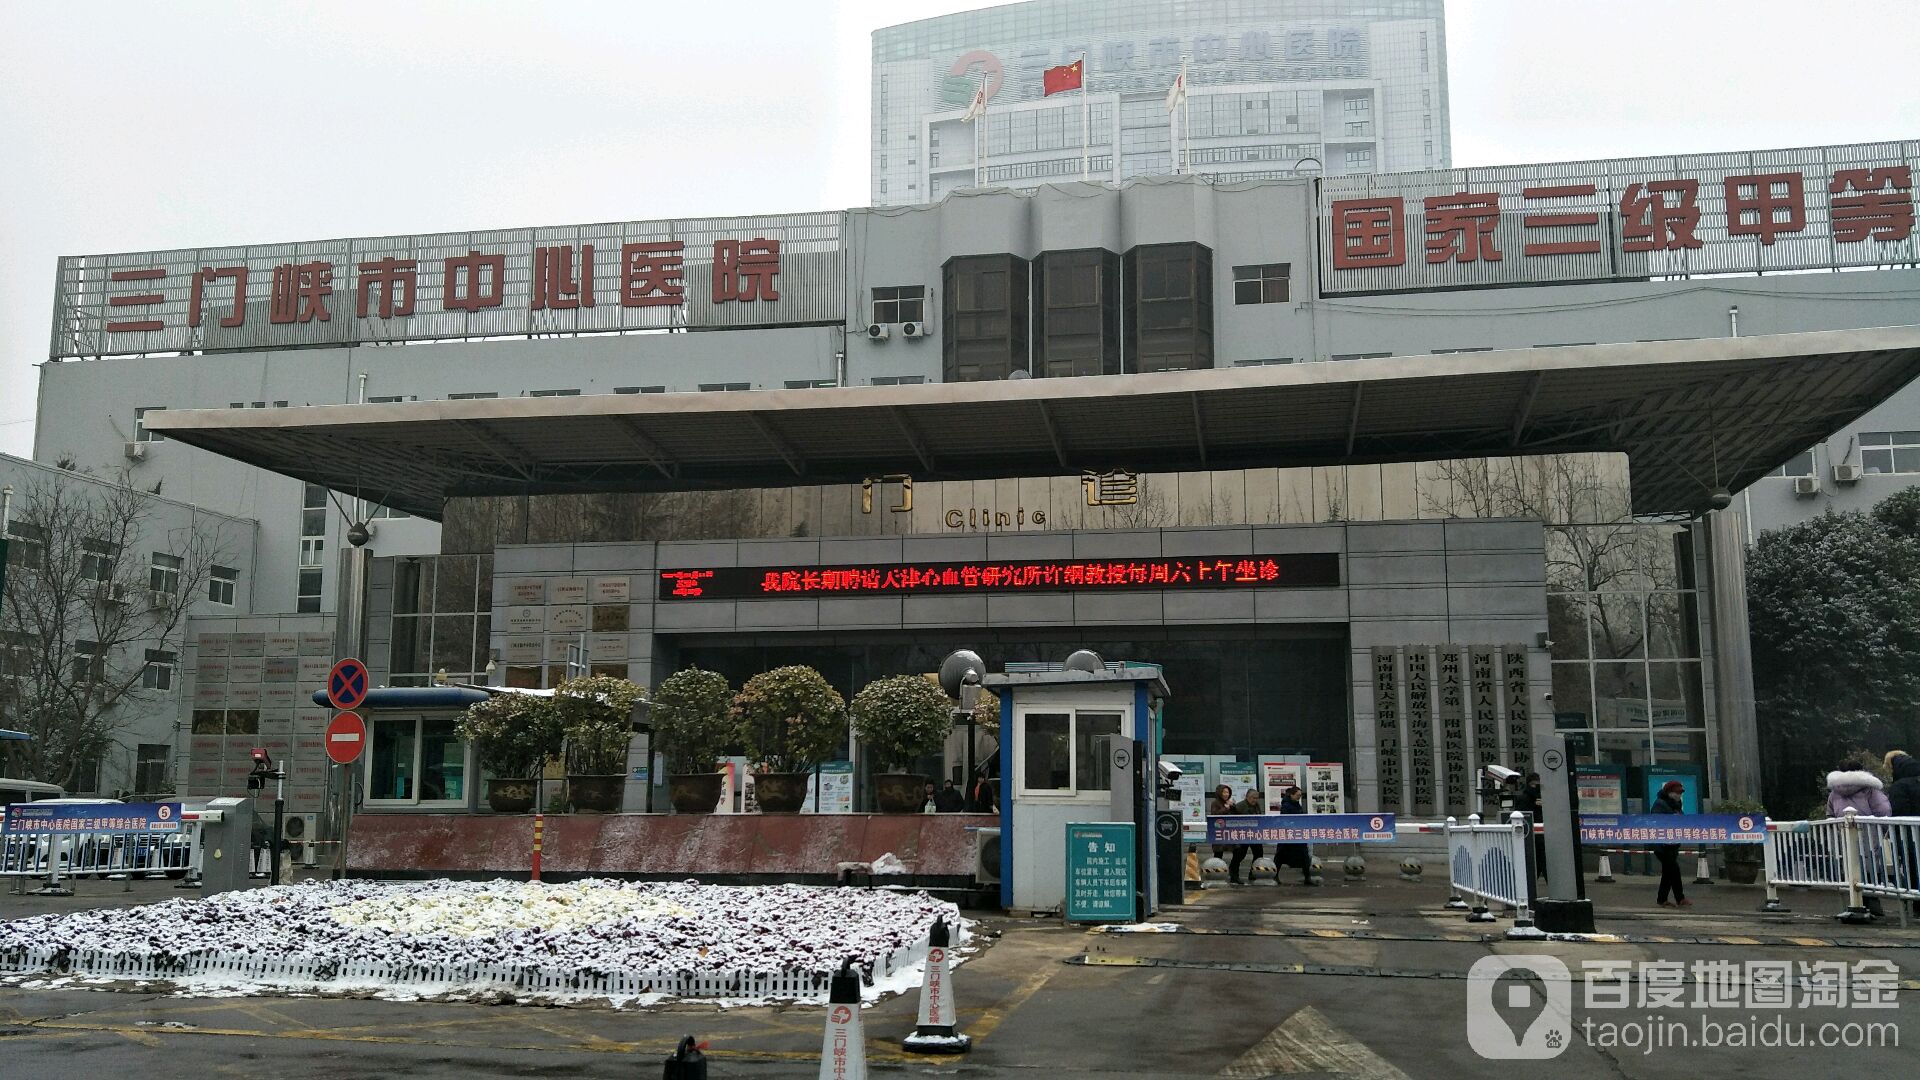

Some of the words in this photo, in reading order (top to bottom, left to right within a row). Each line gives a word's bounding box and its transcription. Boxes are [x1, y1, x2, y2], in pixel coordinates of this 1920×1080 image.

[1019, 28, 1362, 80] 三门峡市中心医院
[1333, 165, 1913, 270] 国家三级甲等
[106, 237, 780, 333] 三门峡市中心医院
[945, 507, 1046, 528] Clinic
[1377, 654, 1400, 805] 河南科技大学附属三门峡市中心医院
[1409, 653, 1432, 805] 中国人民解放军海军总医院协作医院
[1442, 653, 1466, 806] 郑州大学第一附属医院协作医院
[9, 817, 147, 832] 三门峡市中心医院国家三级甲等综合医院
[161, 807, 169, 818] 5
[1372, 819, 1381, 829] 5
[1742, 819, 1750, 829] 5
[1215, 827, 1360, 841] 三门峡市中心医院国家三级甲等综合医院
[1580, 827, 1728, 841] 门峡市中心医院国家三级甲等综合医院
[929, 965, 941, 1024] 三门峡市中心医院
